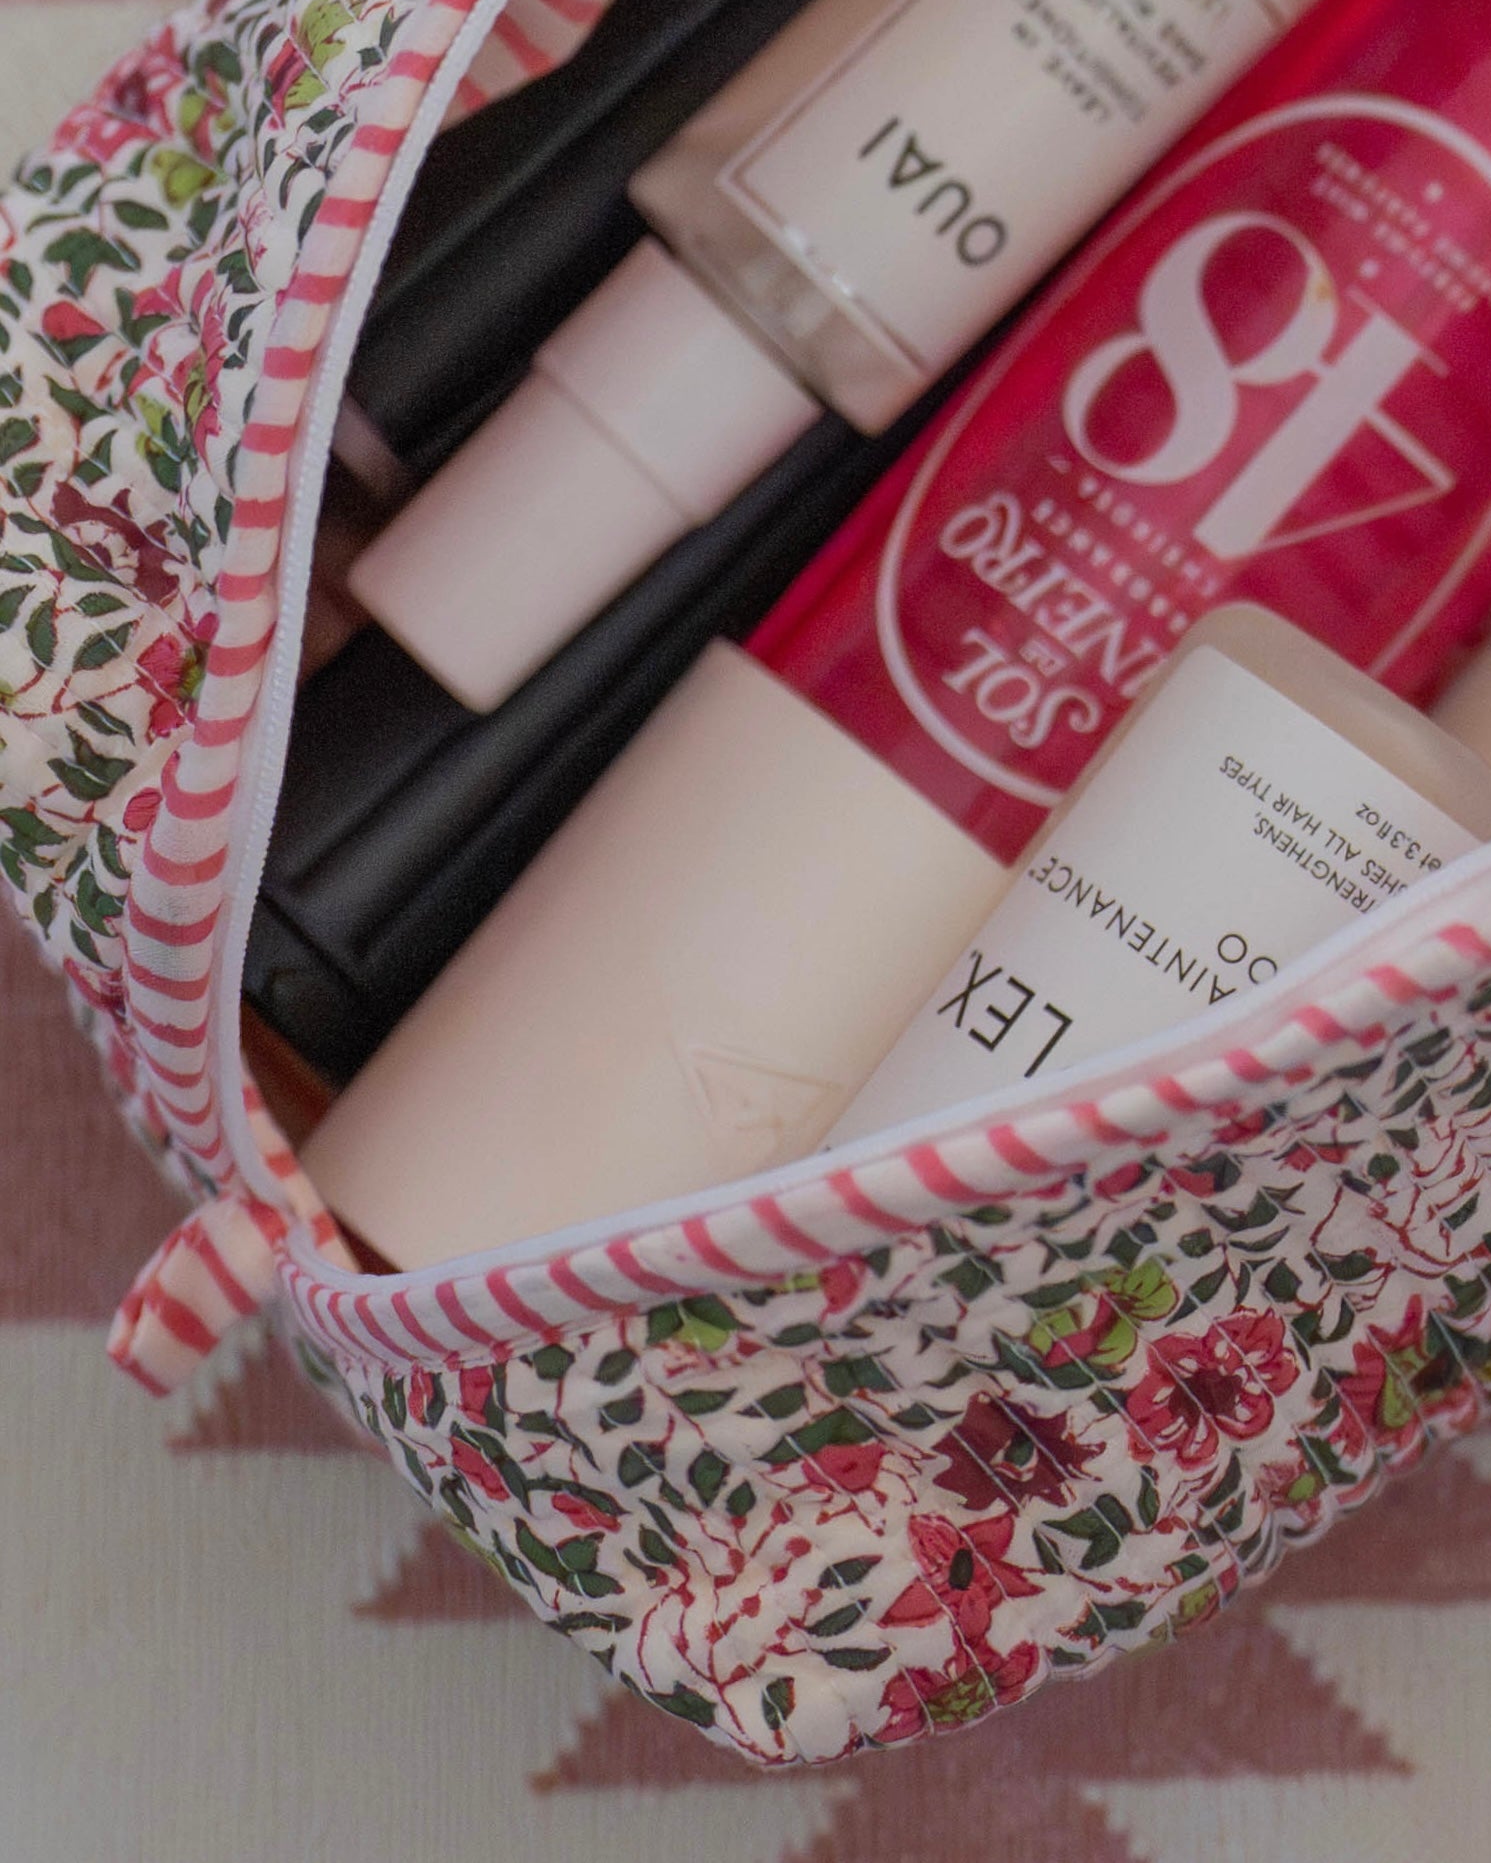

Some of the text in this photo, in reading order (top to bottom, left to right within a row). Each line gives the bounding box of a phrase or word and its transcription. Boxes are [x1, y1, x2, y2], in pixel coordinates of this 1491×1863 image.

[858, 116, 1008, 267] OUAI
[1062, 210, 1454, 560] 48
[939, 491, 1171, 699] NEIRO
[1031, 497, 1189, 633] RAGRANCE
[941, 629, 1099, 749] SOL
[1219, 755, 1272, 802] TYPES
[1273, 792, 1322, 836] HAIR
[1355, 803, 1381, 826] oz
[1254, 812, 1375, 913] TRENGTHENS,
[1324, 828, 1361, 862] ALL
[1033, 856, 1237, 1005] AINTENANCE
